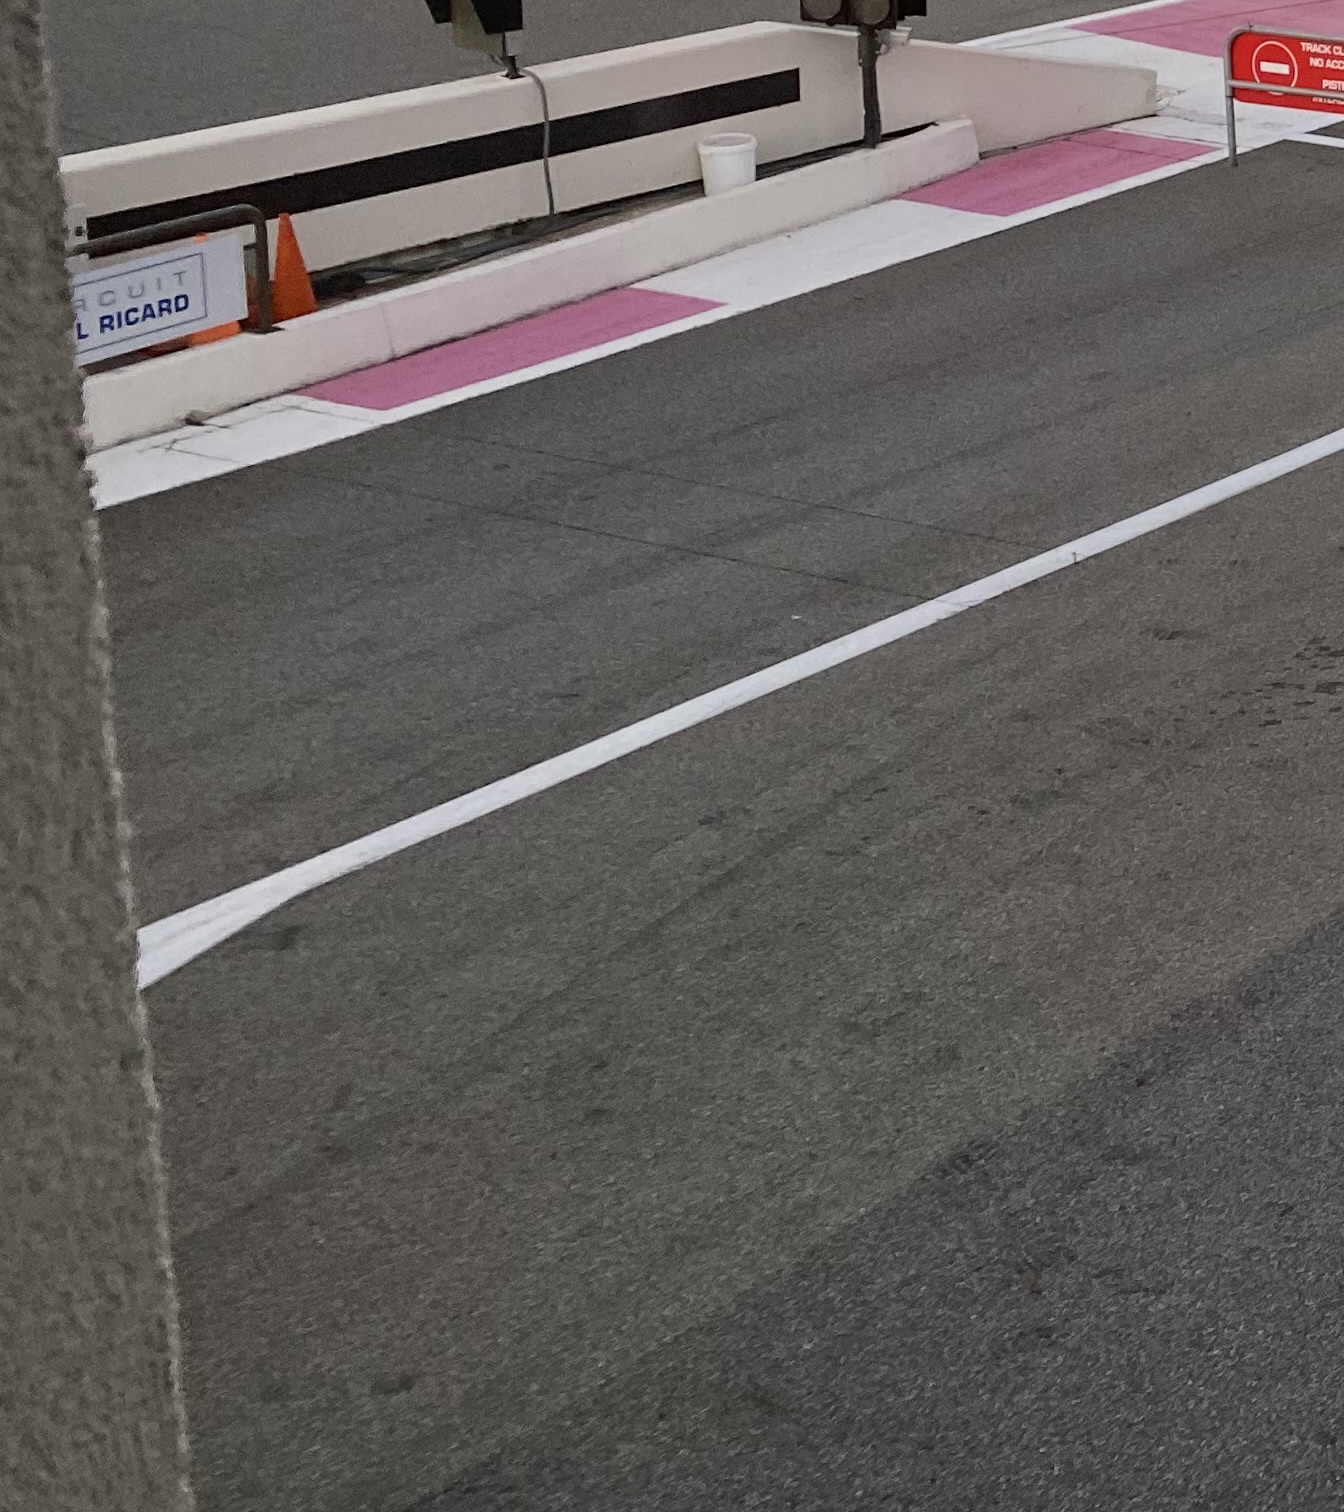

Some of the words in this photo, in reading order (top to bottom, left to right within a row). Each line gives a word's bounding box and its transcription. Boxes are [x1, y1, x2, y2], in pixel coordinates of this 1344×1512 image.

[1300, 41, 1332, 55] TRACK
[1309, 56, 1325, 68] NO
[74, 270, 187, 311] RCUIT
[99, 293, 189, 334] RICARD
